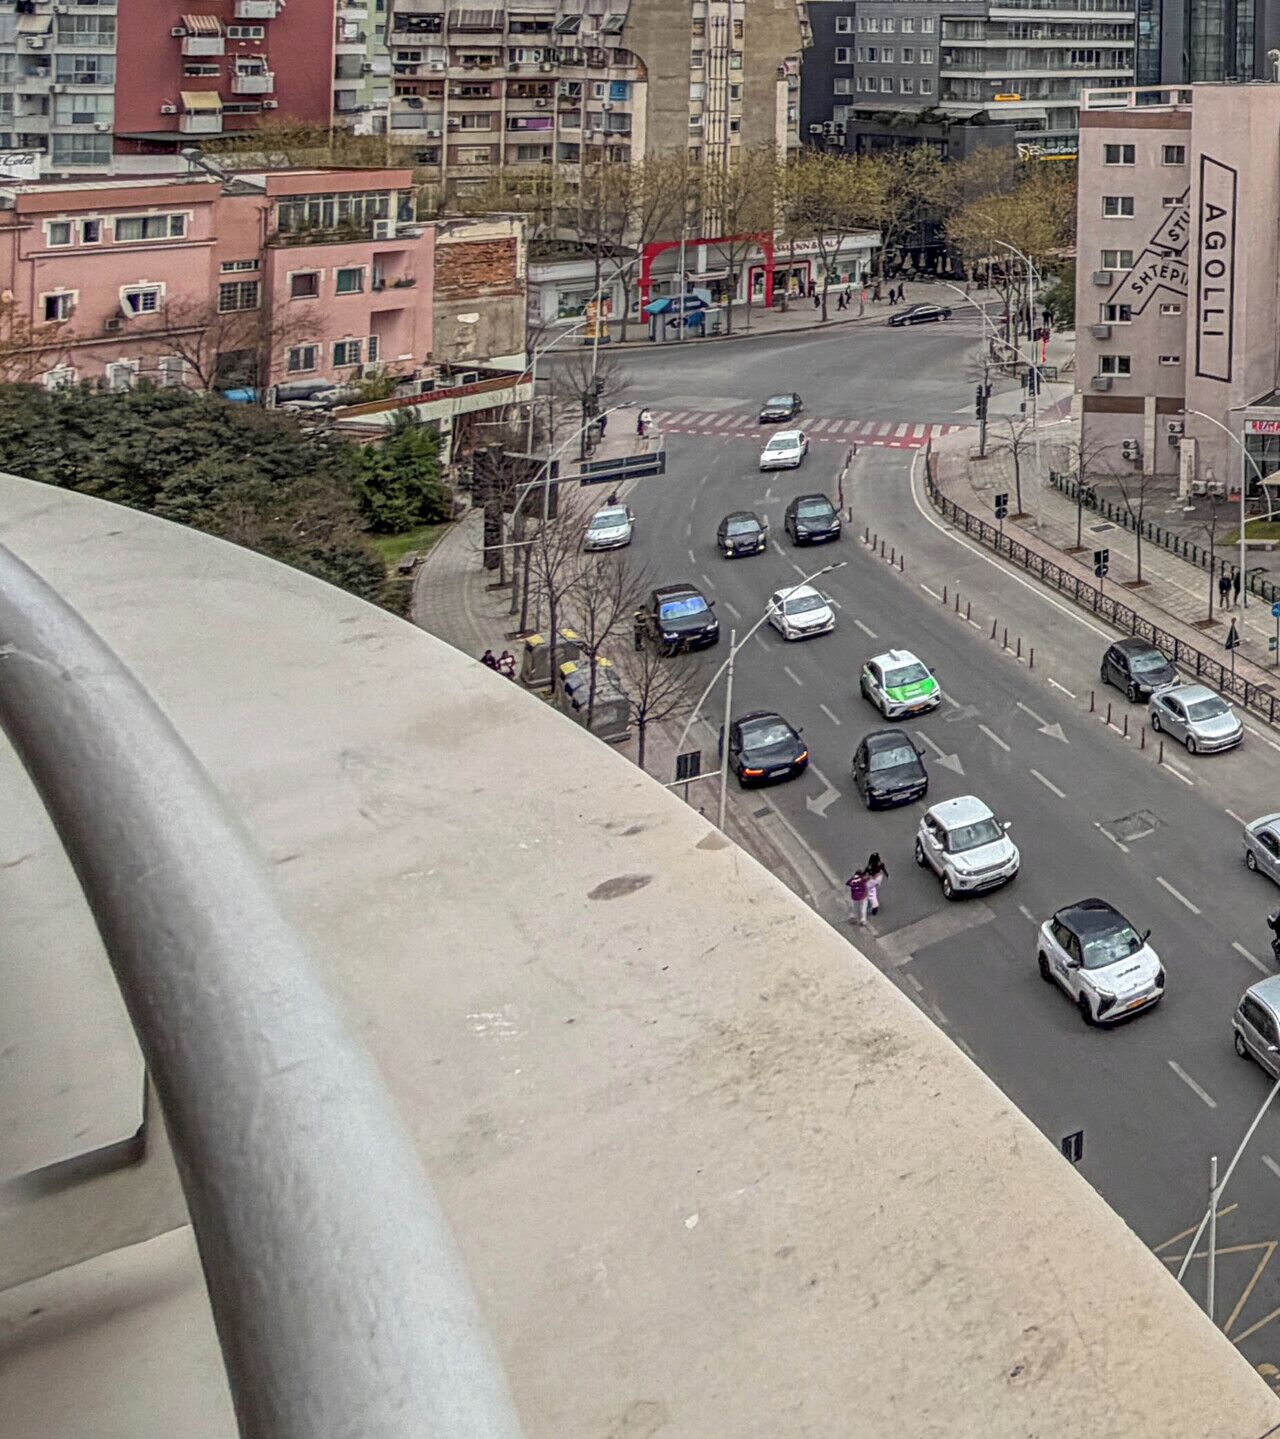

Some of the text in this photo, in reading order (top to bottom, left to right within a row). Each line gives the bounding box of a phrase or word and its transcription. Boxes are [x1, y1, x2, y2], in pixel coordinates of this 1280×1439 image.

[0, 153, 34, 165] Cola
[1168, 205, 1190, 241] STU
[1203, 203, 1227, 336] AGOLLI
